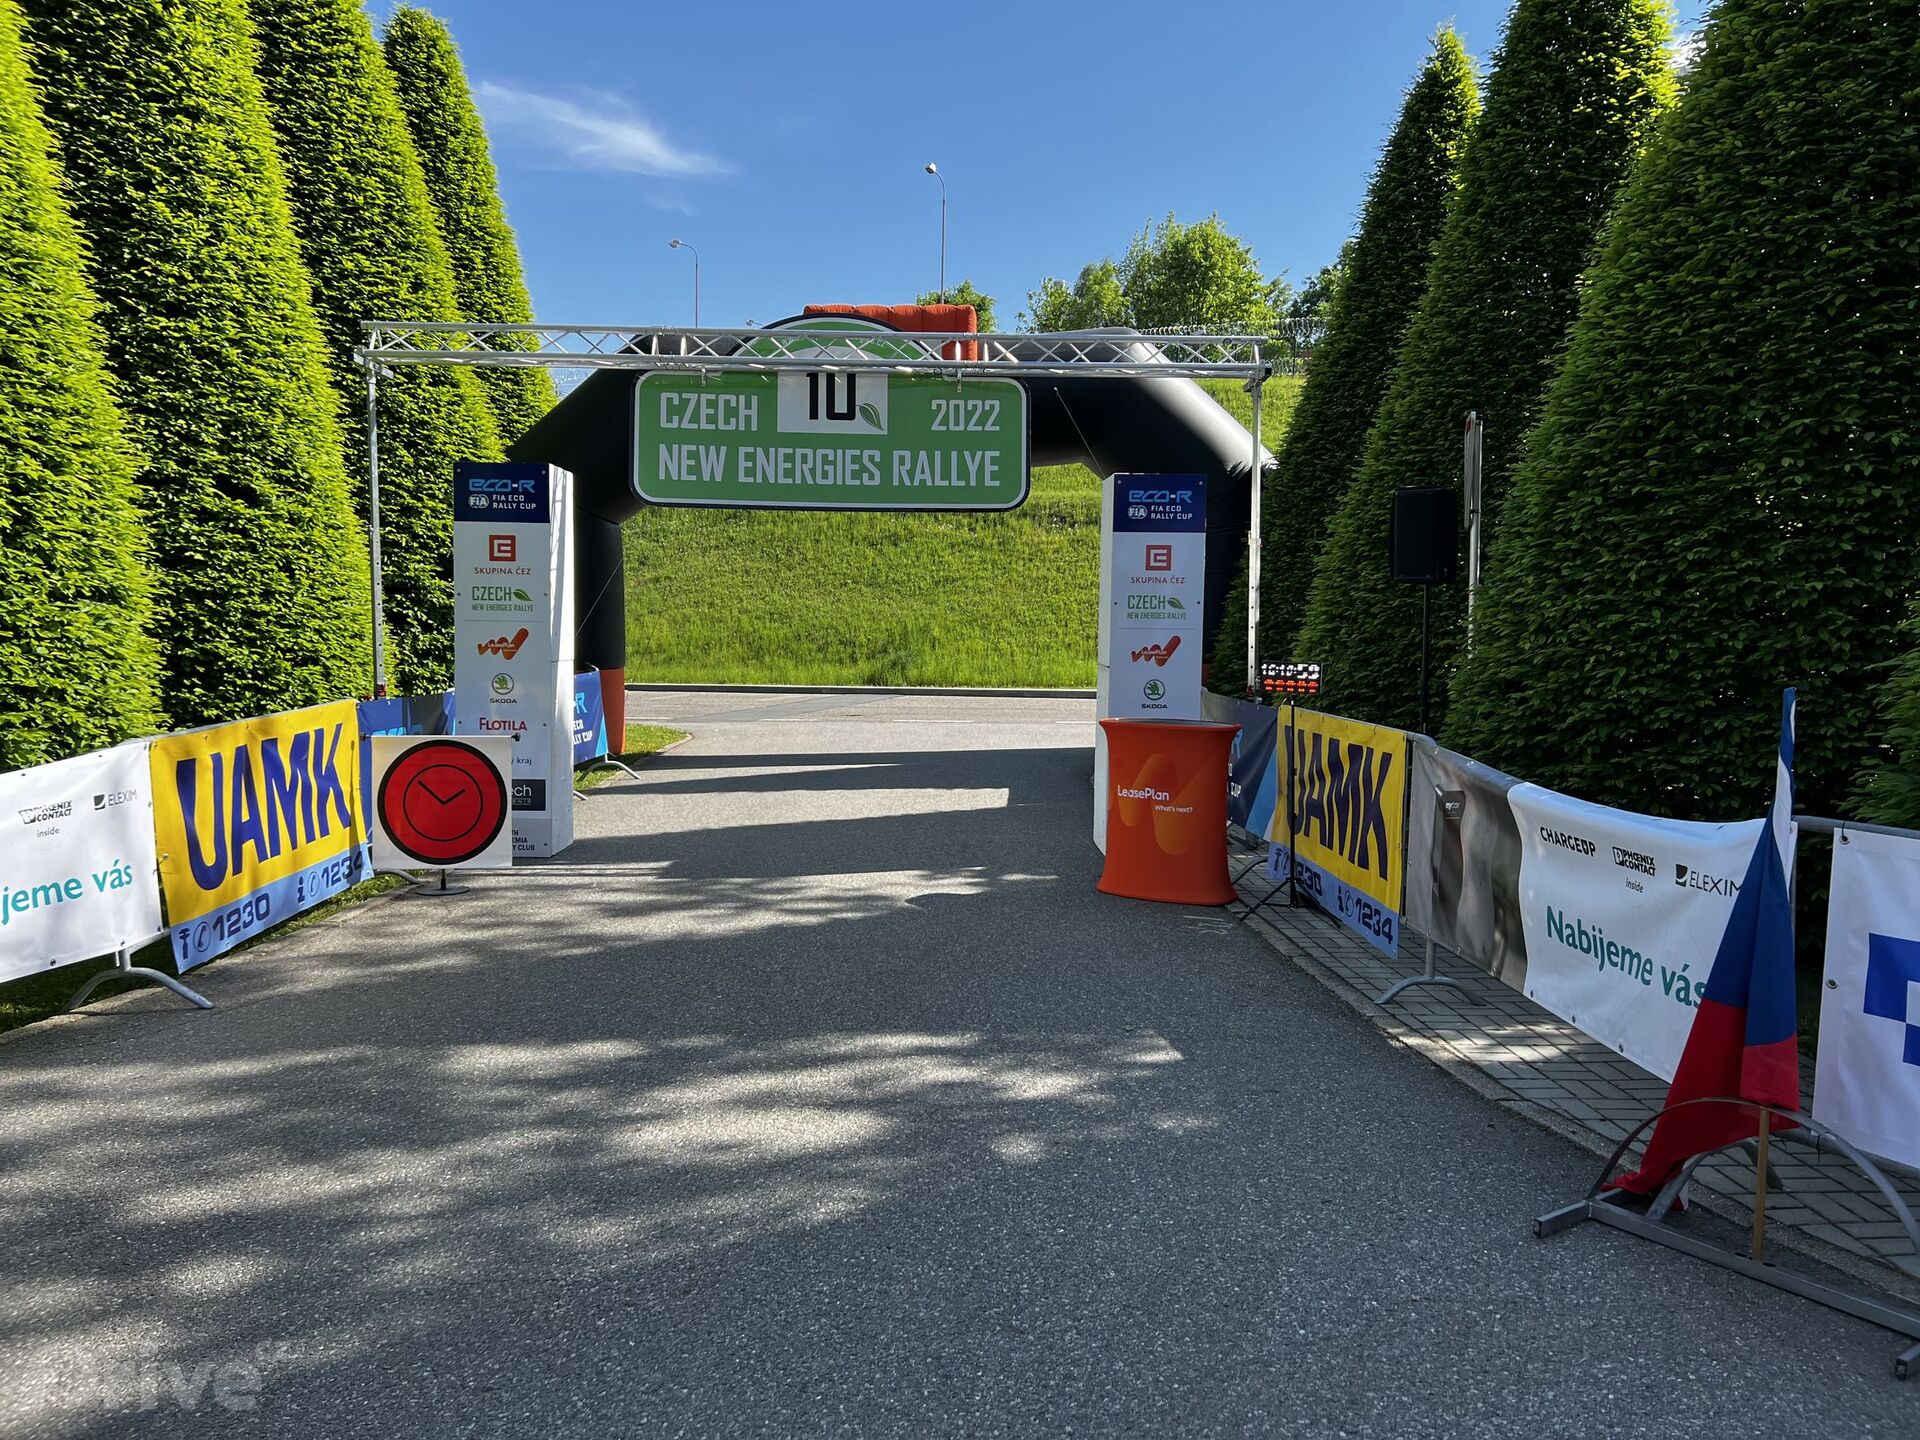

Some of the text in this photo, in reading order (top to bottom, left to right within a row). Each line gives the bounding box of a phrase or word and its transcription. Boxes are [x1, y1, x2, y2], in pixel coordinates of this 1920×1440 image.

[660, 392, 758, 431] CZECH
[931, 400, 1000, 431] 2022
[659, 444, 1000, 486] NEW ENERGIES RALLYE
[474, 565, 531, 576] SKUPINA ČEZ
[1131, 575, 1185, 584] SKUPINA ČEZ
[472, 586, 512, 601] CZECH
[514, 604, 534, 612] RALLYE
[1127, 595, 1166, 610] CZECH
[1167, 612, 1187, 620] RALLYE
[479, 717, 528, 731] FLOTILA
[516, 756, 532, 766] kraj
[1117, 784, 1169, 801] LeasePlan
[176, 723, 352, 891] UAMK
[1155, 804, 1175, 812] What's
[1284, 724, 1393, 882] UAMK
[36, 808, 73, 823] CONTACT
[36, 827, 60, 838] inside
[1540, 826, 1596, 857] CHARGEUP
[321, 851, 364, 889] 1234
[1623, 859, 1656, 877] CONTACT
[1296, 860, 1323, 897] 230
[1625, 877, 1645, 894] inside
[1, 858, 133, 926] jeme vás
[213, 892, 271, 941] 1230
[1355, 897, 1394, 945] 1234
[1546, 905, 1654, 986] Nabijeme
